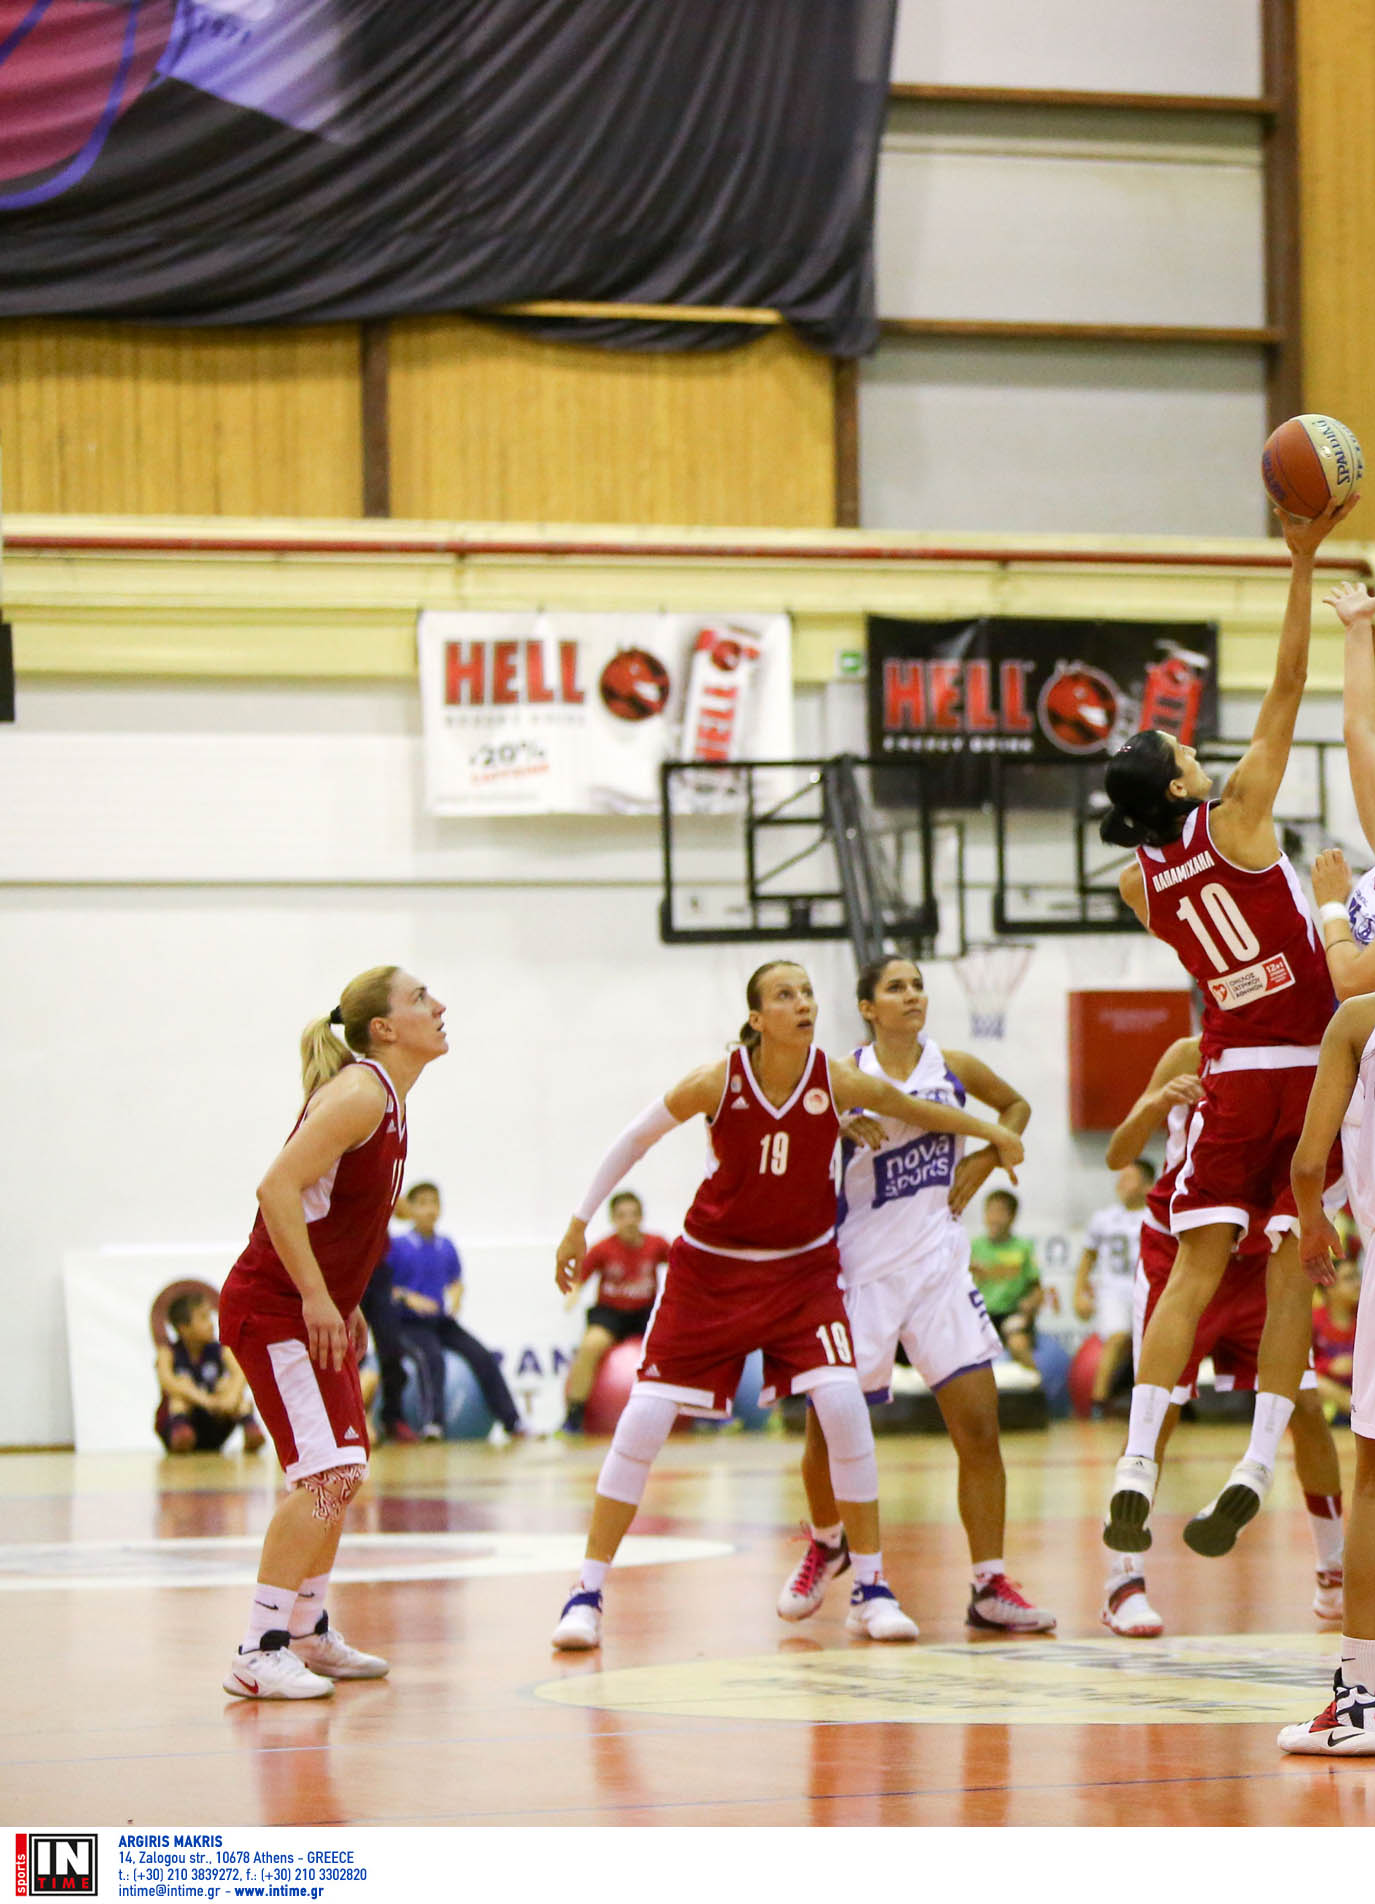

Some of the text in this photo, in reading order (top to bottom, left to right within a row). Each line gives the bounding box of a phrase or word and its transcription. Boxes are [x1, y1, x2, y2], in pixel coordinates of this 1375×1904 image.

[1317, 419, 1350, 485] SPALDING
[445, 640, 585, 706] HELL
[883, 660, 1032, 731] HELL
[1176, 882, 1260, 973] 10
[759, 1131, 789, 1176] 19
[886, 1136, 949, 1179] nova
[816, 1321, 852, 1365] 19
